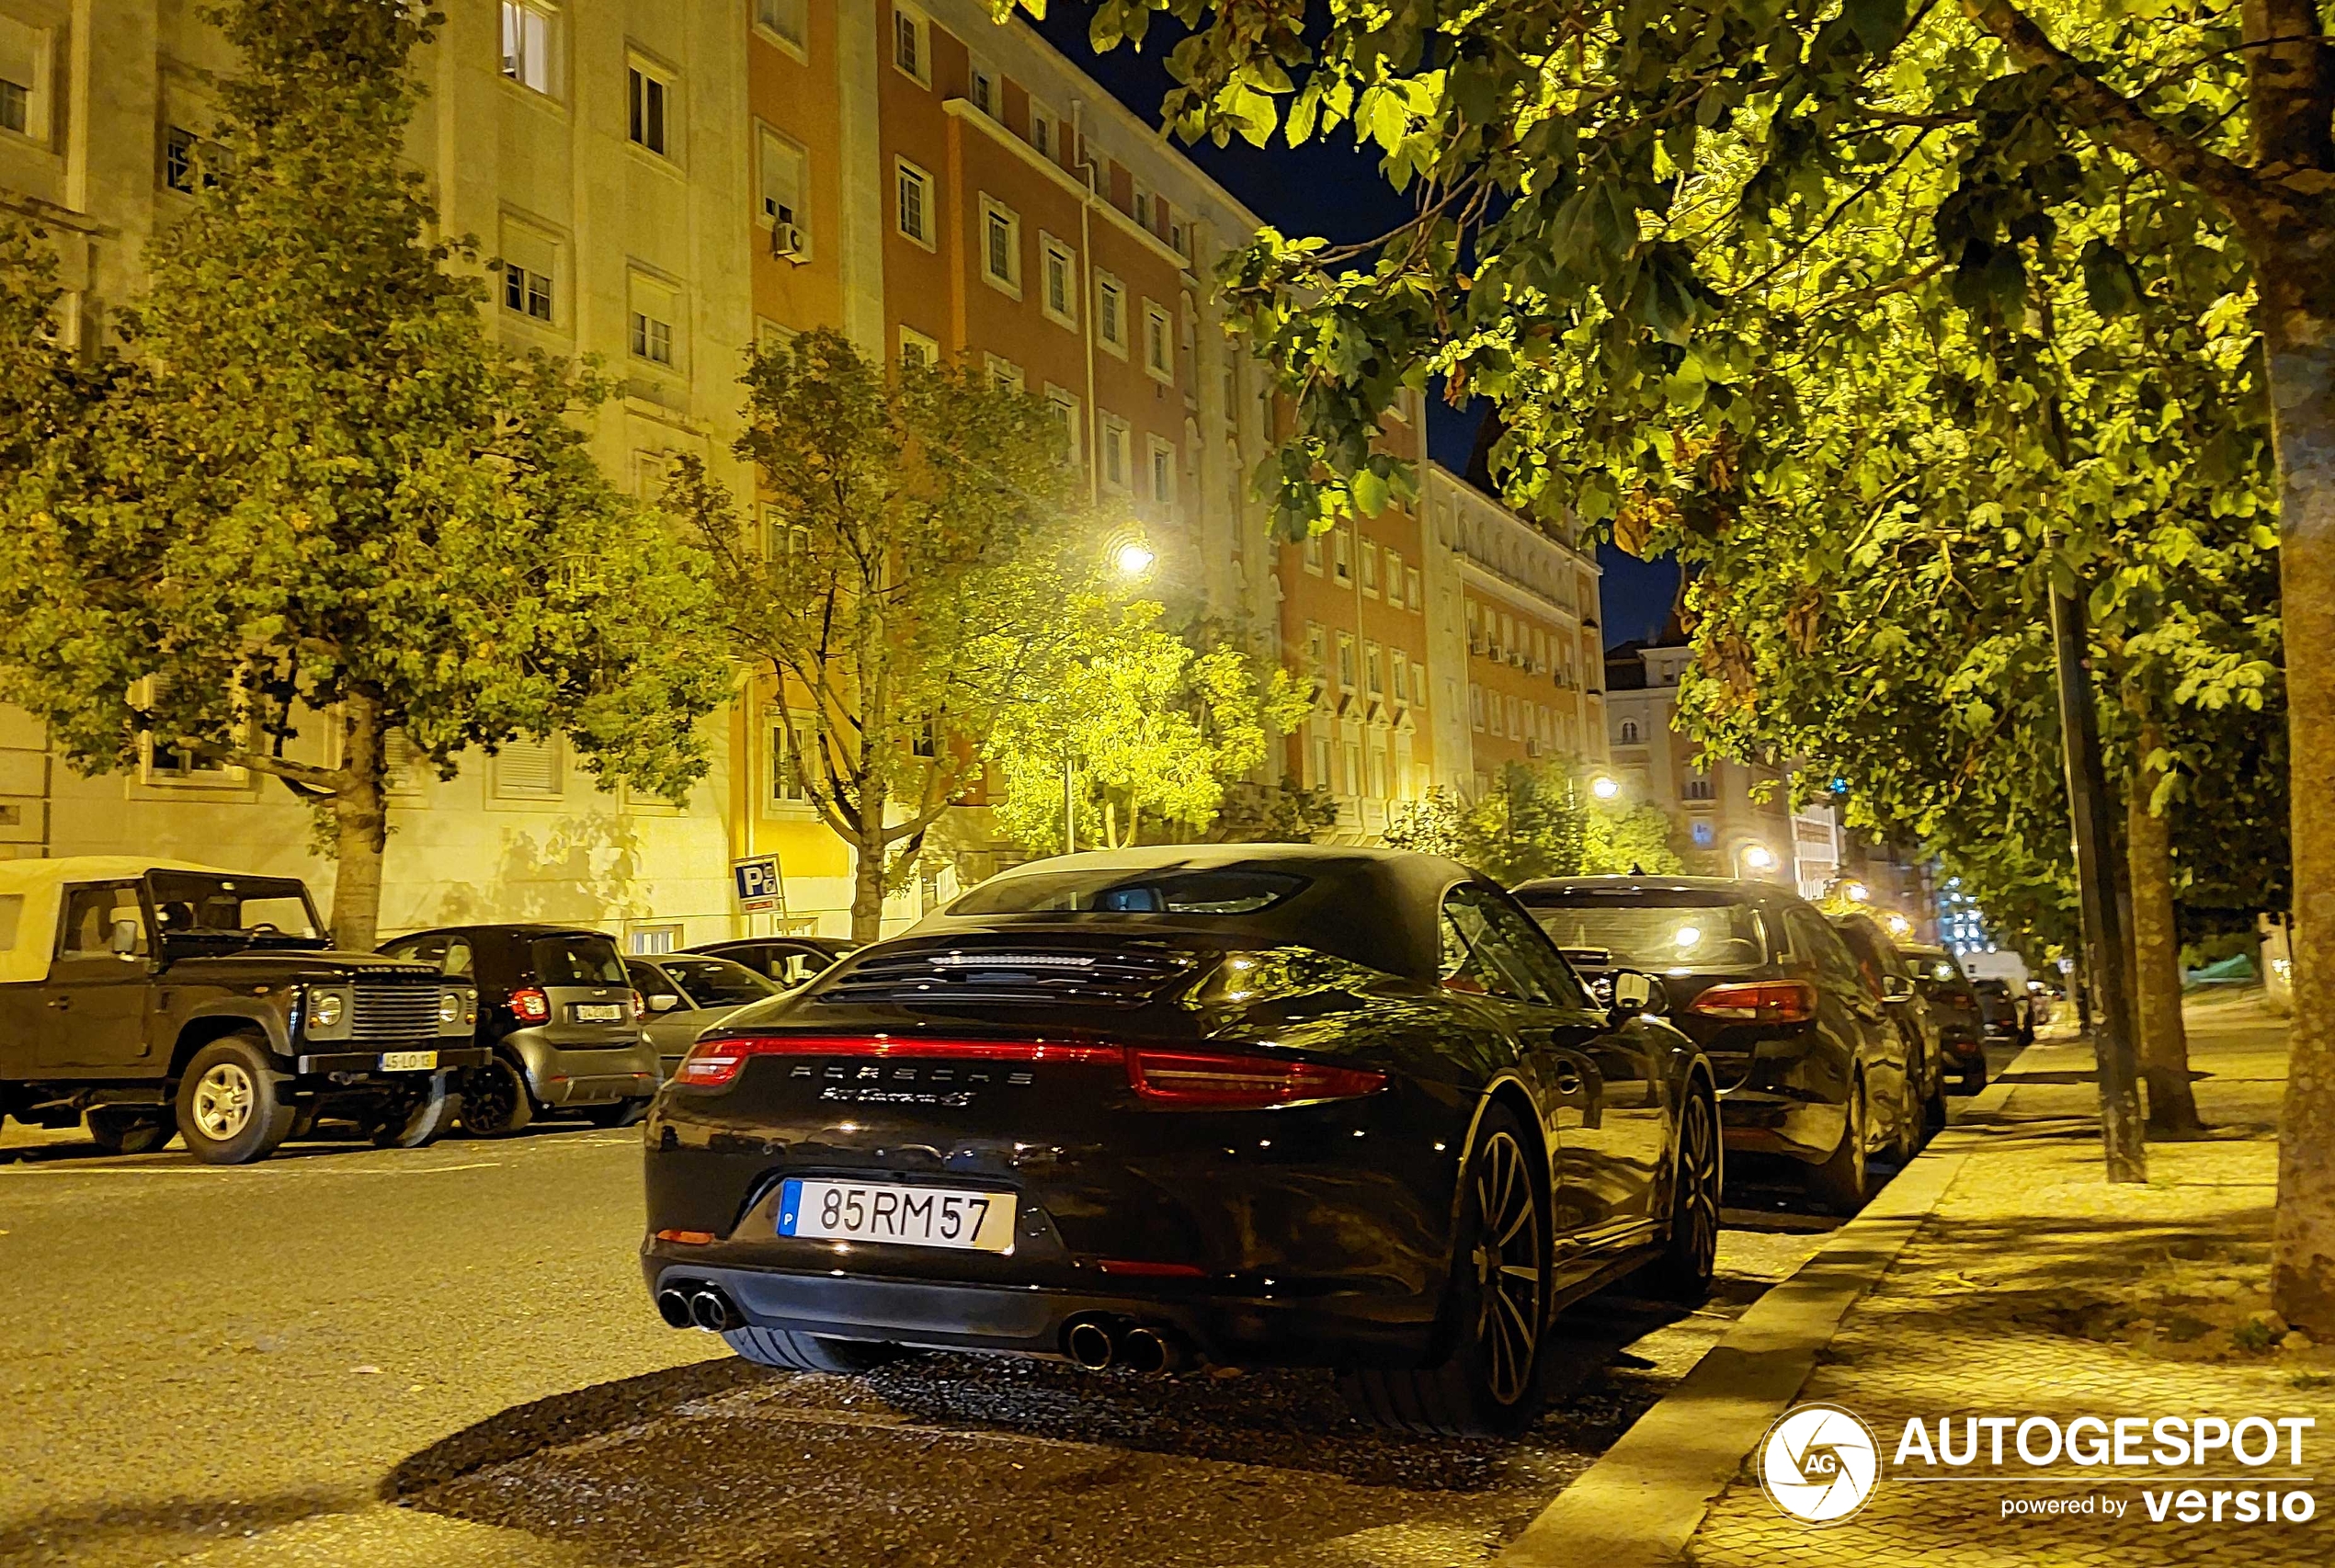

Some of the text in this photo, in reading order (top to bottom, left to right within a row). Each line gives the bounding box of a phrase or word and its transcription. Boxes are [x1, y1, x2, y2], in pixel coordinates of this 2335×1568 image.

[744, 867, 763, 895] P
[789, 1065, 1034, 1085] PORSCHE
[784, 1212, 792, 1226] P
[821, 1188, 990, 1242] 85RM57
